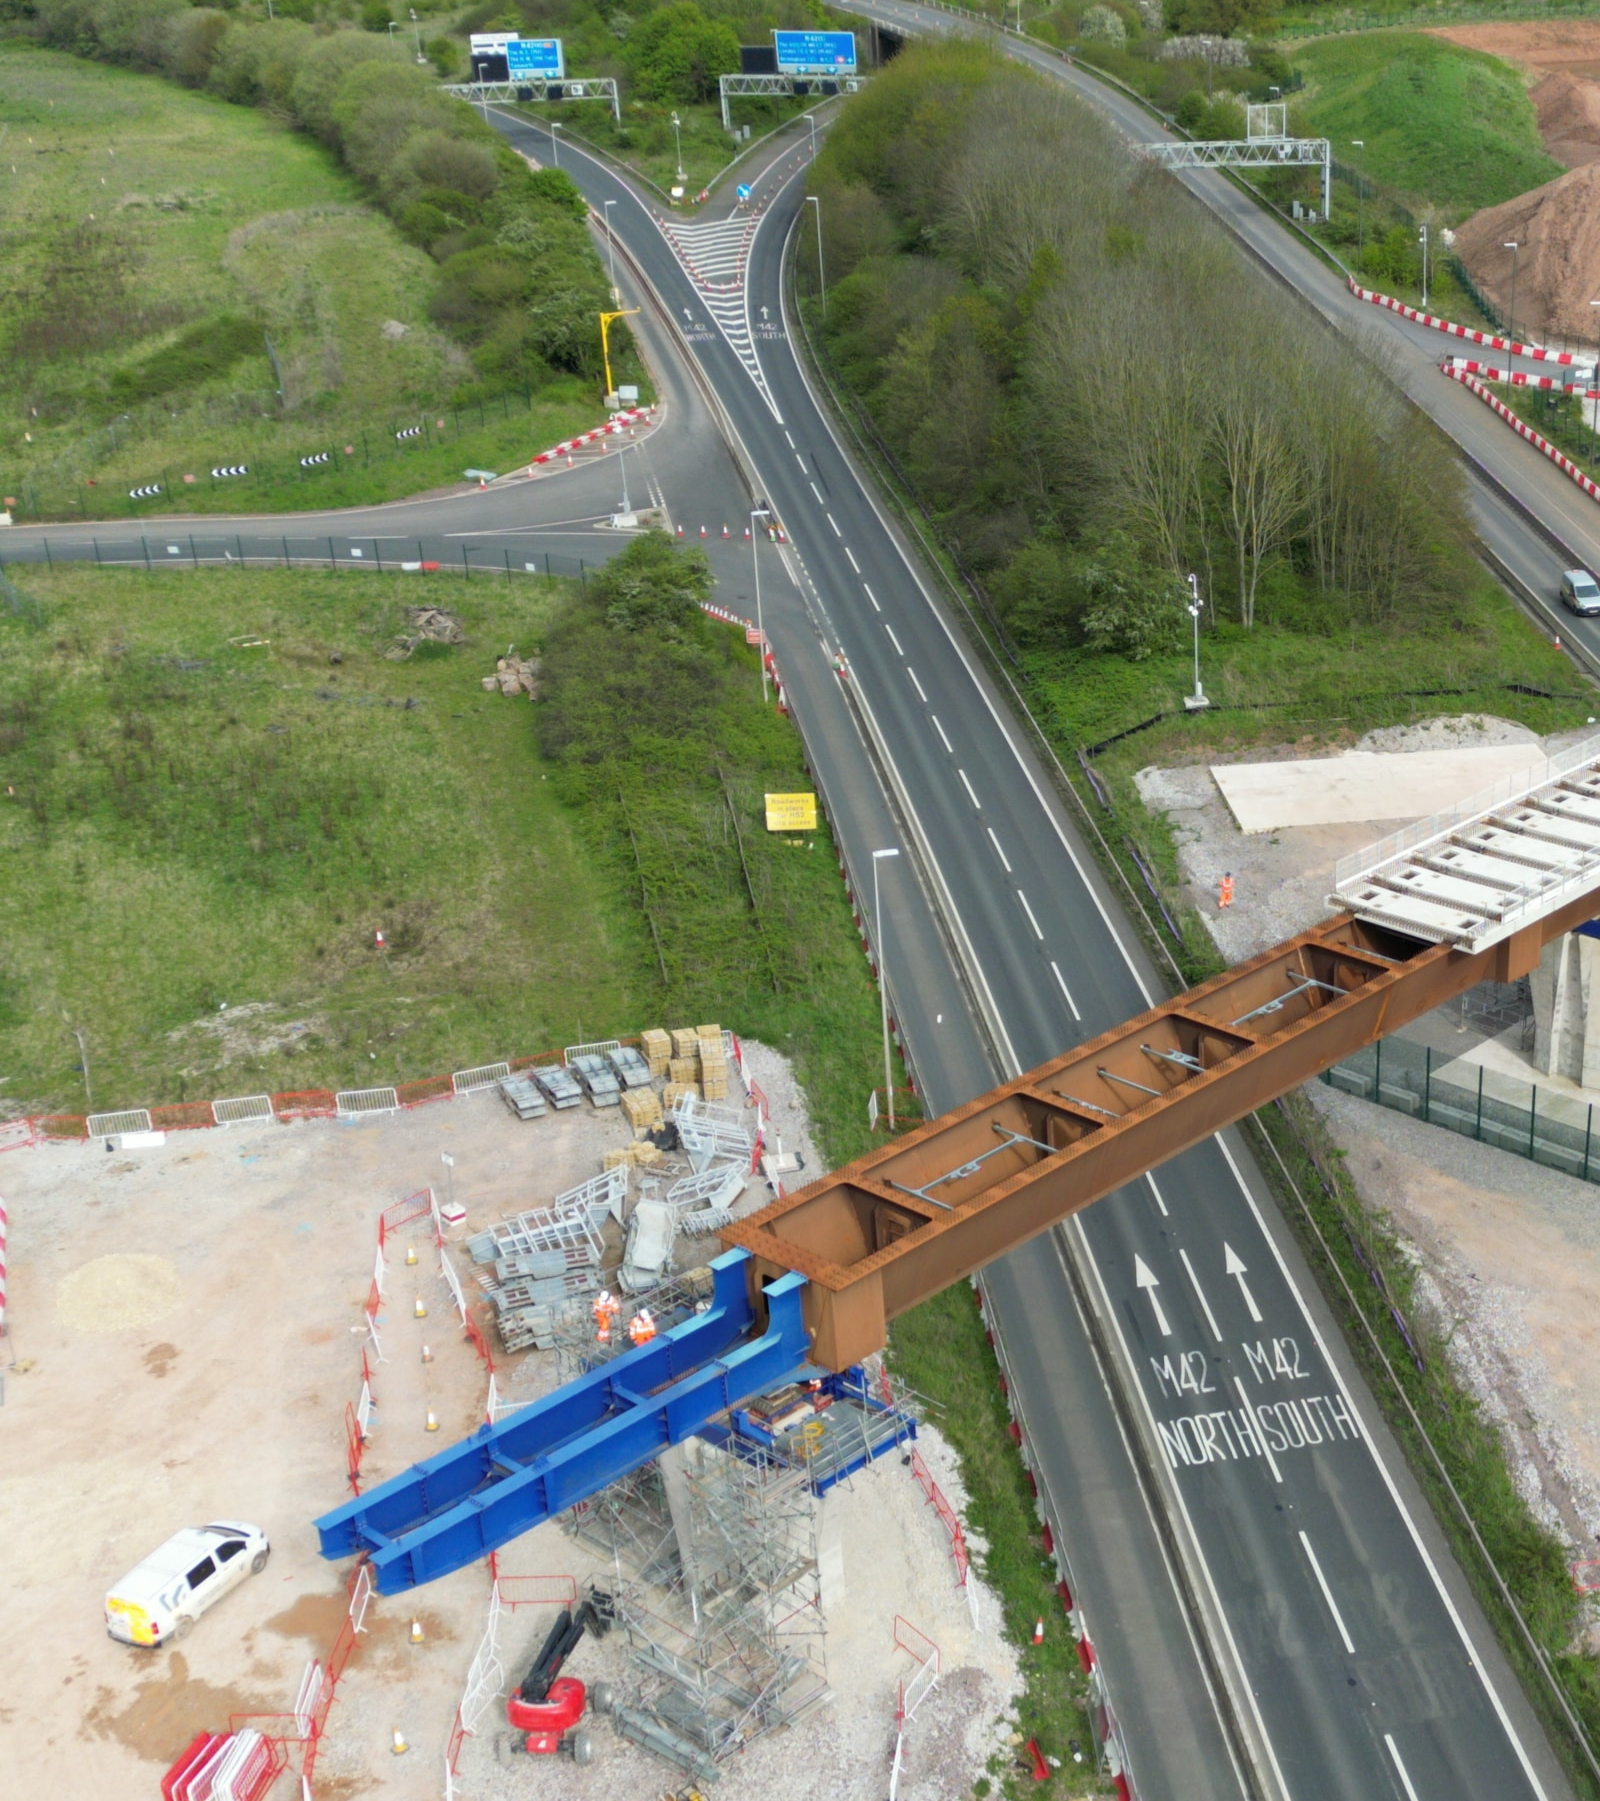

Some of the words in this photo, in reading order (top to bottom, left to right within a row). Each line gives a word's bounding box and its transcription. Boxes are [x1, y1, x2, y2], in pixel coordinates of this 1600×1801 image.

[752, 331, 787, 340] SOUTH
[1150, 1350, 1216, 1399] M42
[1242, 1336, 1310, 1384] M42
[1157, 1408, 1262, 1468] NORTH
[1256, 1394, 1359, 1452] SOUTH
